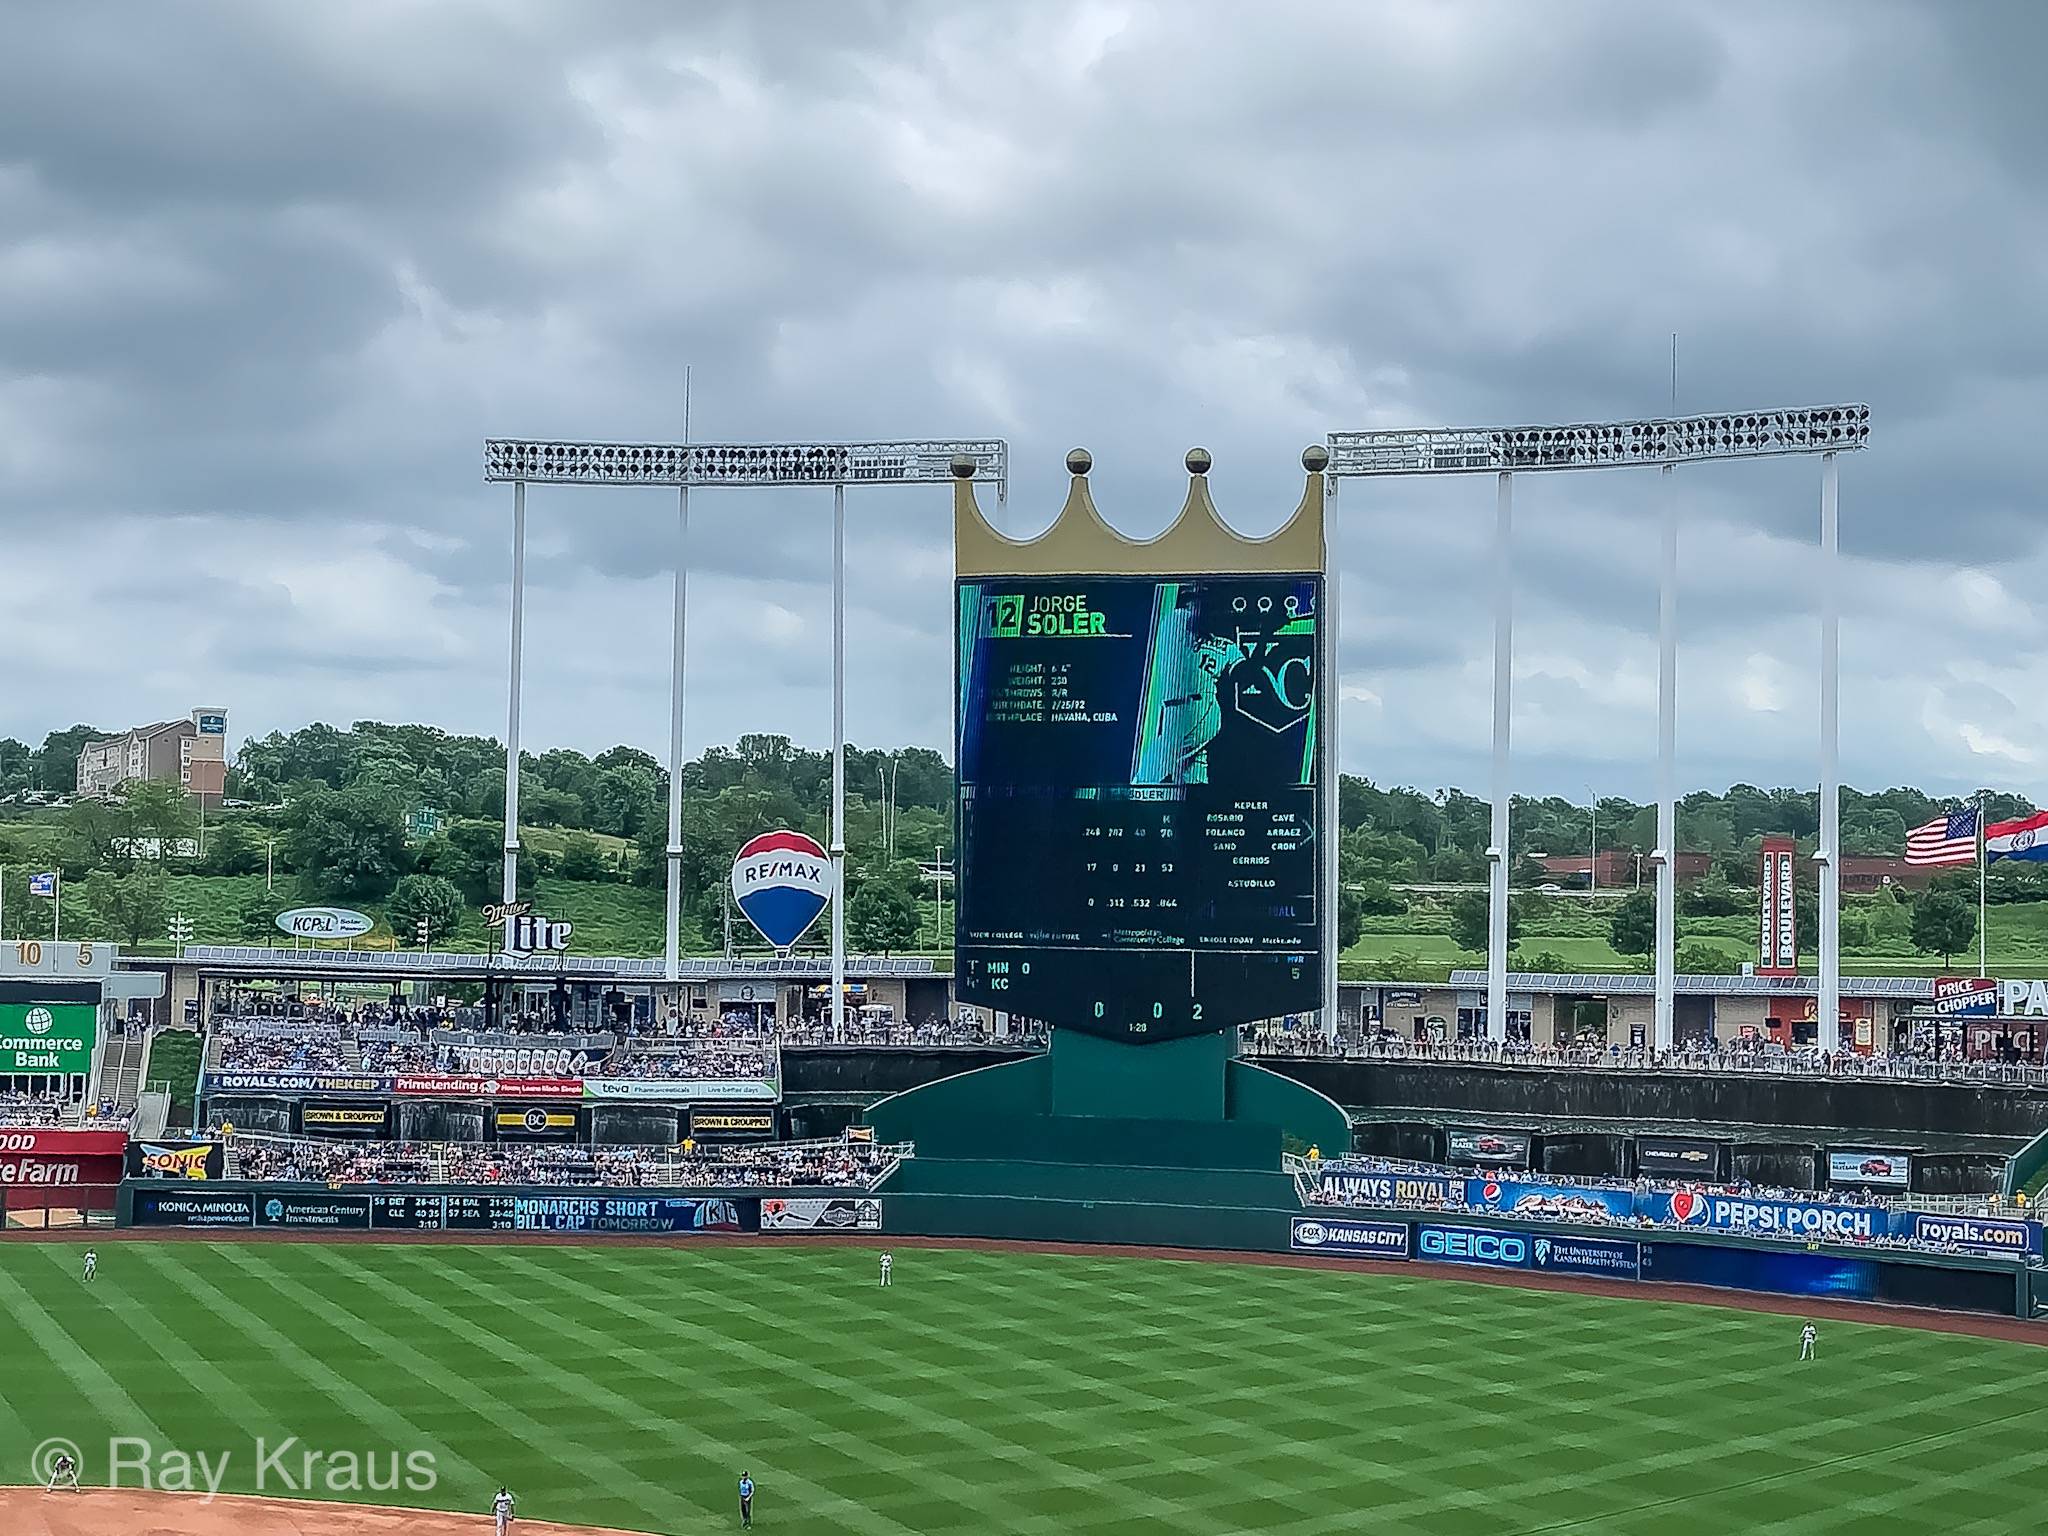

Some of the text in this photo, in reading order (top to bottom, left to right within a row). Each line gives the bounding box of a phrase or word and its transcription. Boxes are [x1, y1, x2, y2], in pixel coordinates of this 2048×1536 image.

[1029, 595, 1087, 612] JORGE
[1027, 612, 1107, 634] SOLER
[1092, 712, 1119, 721] CUBA
[1234, 801, 1269, 811] KEPLER
[1206, 814, 1244, 823] ROSARIO
[1271, 814, 1296, 823] CAVE
[1266, 828, 1302, 837] ARRAEZ
[1270, 842, 1297, 851] CRON
[745, 861, 821, 884] RE/MAX
[1086, 862, 1097, 872] 17
[1227, 879, 1276, 888] ASTUDILLO
[482, 902, 532, 928] Miller
[1761, 860, 1773, 959] BOULEVARD
[1778, 860, 1792, 959] BOULEVARD
[292, 916, 334, 932] KCP&L
[500, 914, 573, 960] Lite
[14, 942, 42, 965] 10
[76, 943, 94, 968] 5
[987, 962, 1010, 974] MIN
[1022, 962, 1031, 975] 0
[991, 978, 1009, 990] KC
[1937, 979, 1975, 997] PRICE
[1936, 991, 1997, 1014] CHOPPER
[2003, 981, 2048, 1016] PA
[1192, 1004, 1203, 1020] 2
[0, 1034, 83, 1051] ommerce
[15, 1051, 60, 1067] Bank
[222, 1075, 379, 1091] ROYALS.COM/THEKEEP
[397, 1079, 480, 1093] PrimeLending
[602, 1082, 629, 1093] teva
[742, 1086, 760, 1095] days
[306, 1111, 334, 1121] BROWN
[528, 1114, 546, 1127] BC
[694, 1117, 721, 1127] BROWN
[730, 1117, 770, 1128] CROUPPEN
[146, 1153, 207, 1171] SONIC
[18, 1158, 79, 1186] Farm
[1323, 1175, 1391, 1199] ALWAYS
[1395, 1180, 1447, 1201] ROYAL
[158, 1202, 250, 1213] KONICA MINOLTA
[285, 1204, 366, 1217] American Century
[515, 1200, 599, 1216] MONARCHS
[605, 1200, 658, 1217] SHORT
[285, 1214, 339, 1224] Investments
[417, 1220, 439, 1229] 3:10
[491, 1221, 512, 1230] 3:10
[515, 1215, 674, 1230] BILL CAP TOMORROW
[1715, 1201, 1871, 1236] PEPSI PORCH
[1302, 1227, 1405, 1246] FOX KANSAS CITY
[1921, 1220, 2024, 1246] royals.com
[1420, 1230, 1526, 1264] GEICO
